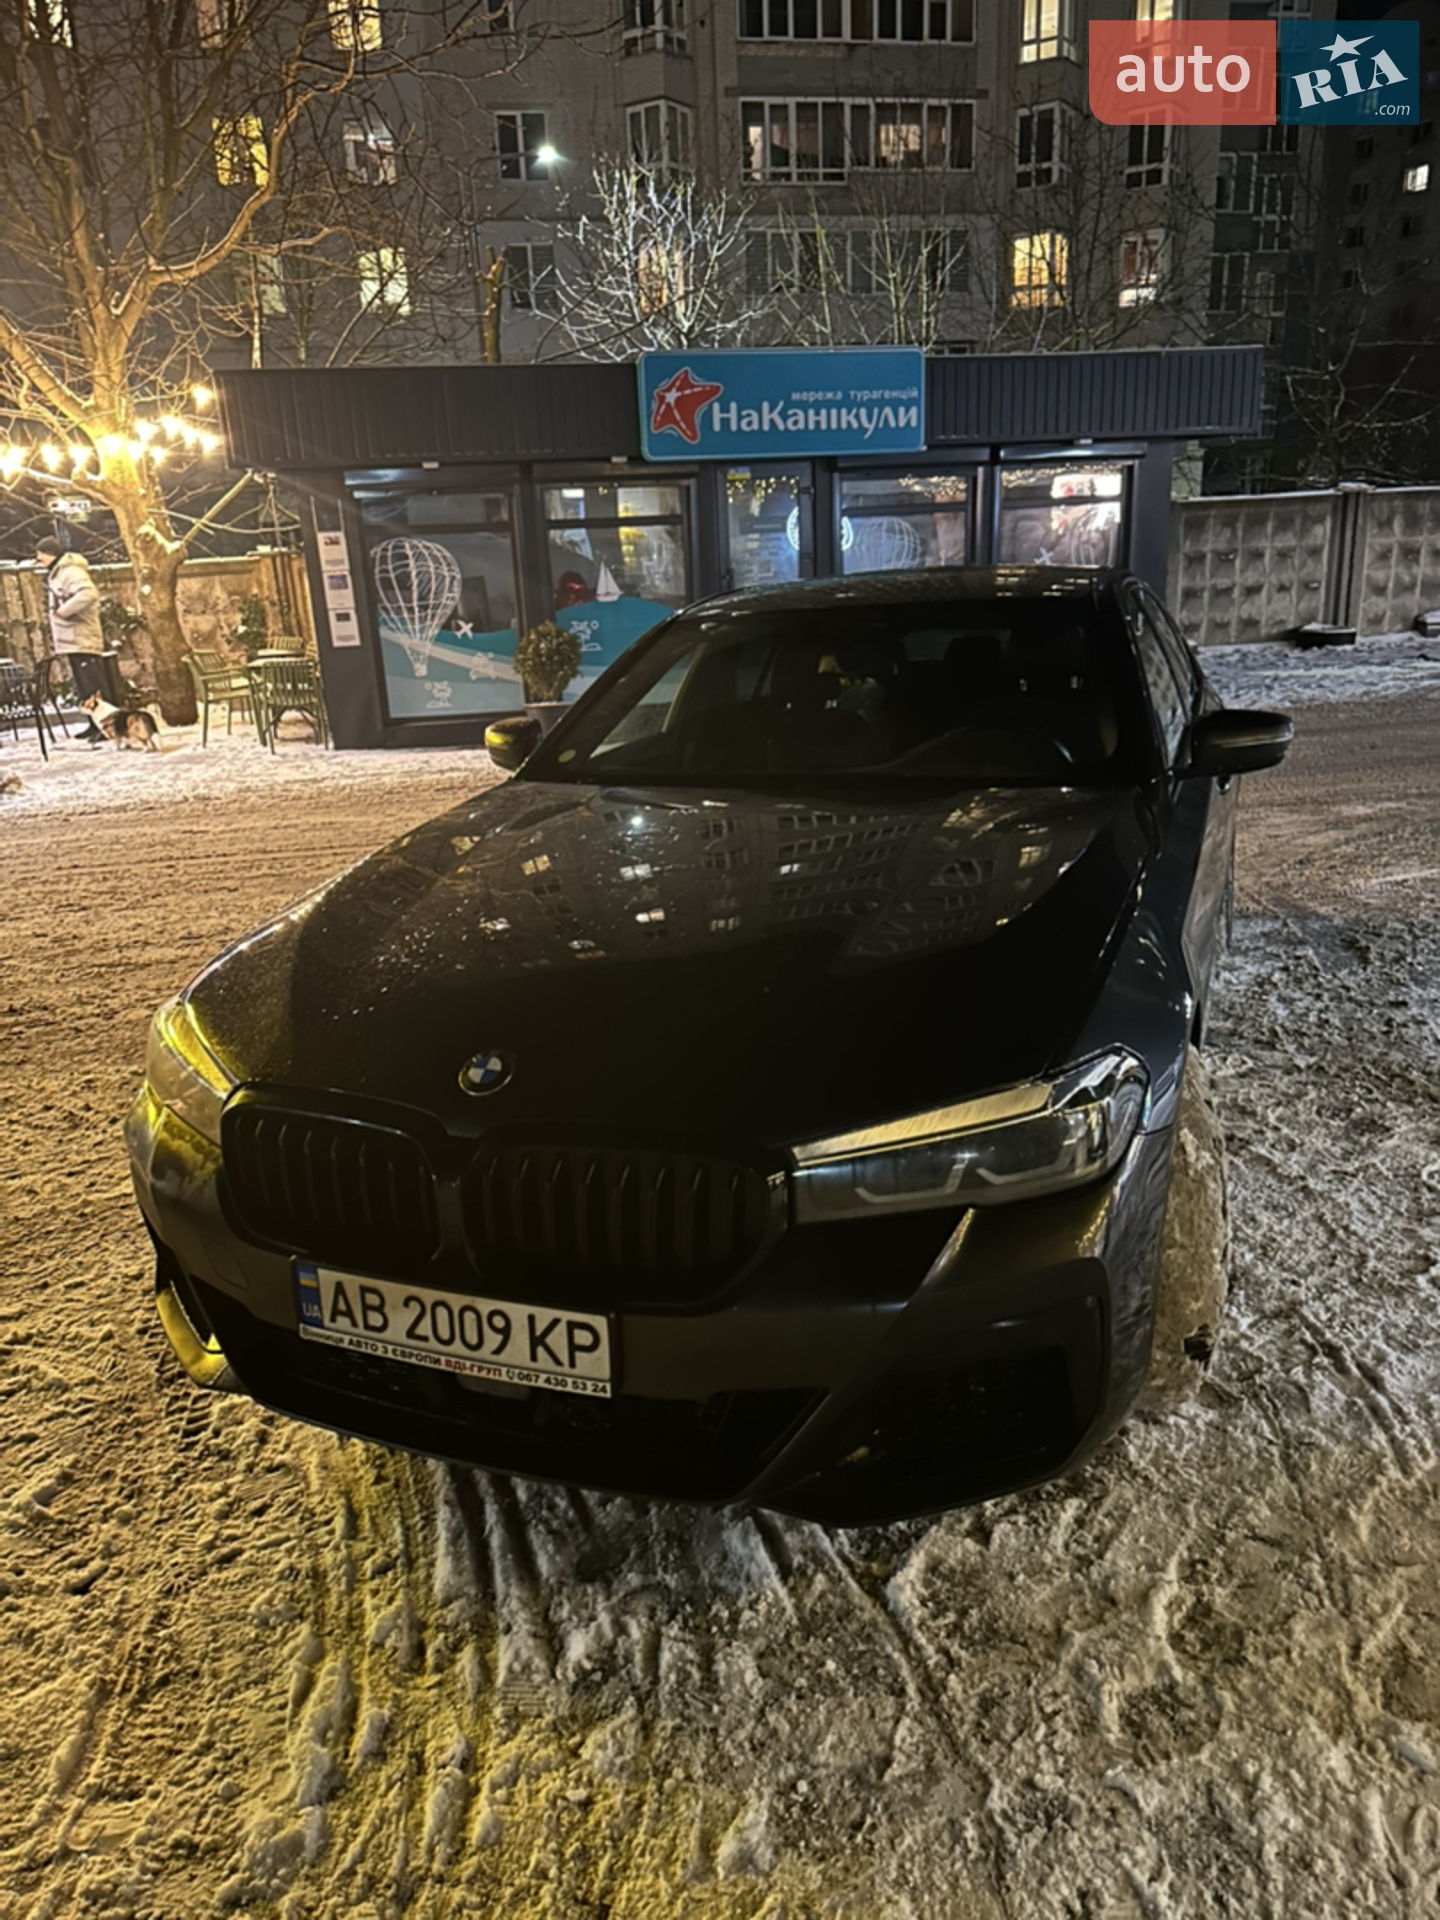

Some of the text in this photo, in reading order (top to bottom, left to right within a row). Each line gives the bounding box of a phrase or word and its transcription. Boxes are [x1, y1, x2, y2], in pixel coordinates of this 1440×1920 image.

[791, 386, 919, 404] мережа турагенцій
[712, 400, 919, 440] НаКанікули
[302, 1301, 322, 1319] UA
[328, 1280, 602, 1370] AB 2009 KP
[346, 1337, 379, 1353] АВТО
[391, 1347, 442, 1367] ЄВРОПИ
[517, 1370, 541, 1384] 067
[544, 1374, 568, 1389] 430
[571, 1379, 588, 1393] 53
[591, 1382, 609, 1395] 24
